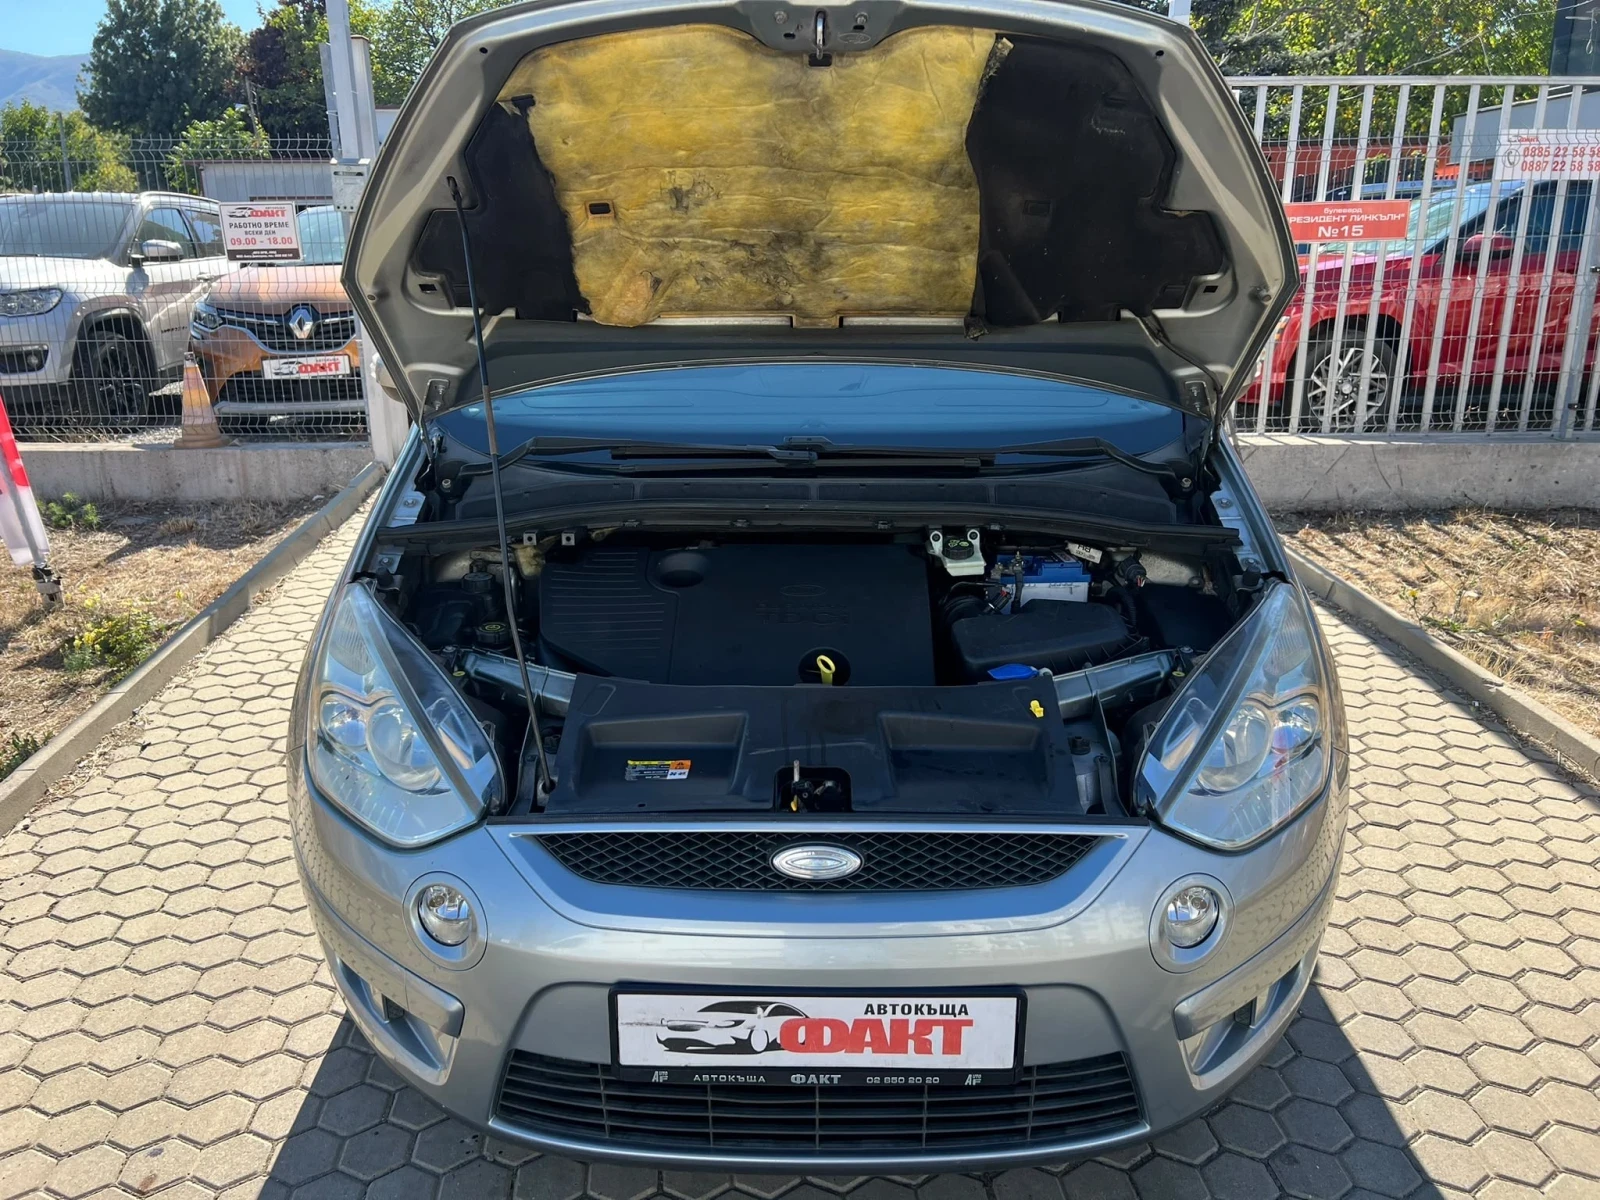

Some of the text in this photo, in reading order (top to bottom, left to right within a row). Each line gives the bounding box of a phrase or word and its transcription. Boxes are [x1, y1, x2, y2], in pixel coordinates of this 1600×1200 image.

[1523, 146, 1550, 158] 0885
[1553, 146, 1569, 158] 22
[1572, 146, 1586, 158] 58
[1520, 160, 1549, 172] 0887
[1551, 160, 1567, 172] 22
[1570, 160, 1584, 172] 58
[264, 221, 290, 229] ВРЕМЕ
[230, 237, 257, 246] 09.00
[267, 236, 293, 245] 18.00
[863, 1003, 969, 1018] АВТОКЪЩА
[779, 1017, 974, 1056] ФАКТ
[790, 1074, 842, 1085] ФАКТ
[866, 1076, 881, 1084] 02
[908, 1076, 923, 1084] 20
[925, 1076, 940, 1084] 20
